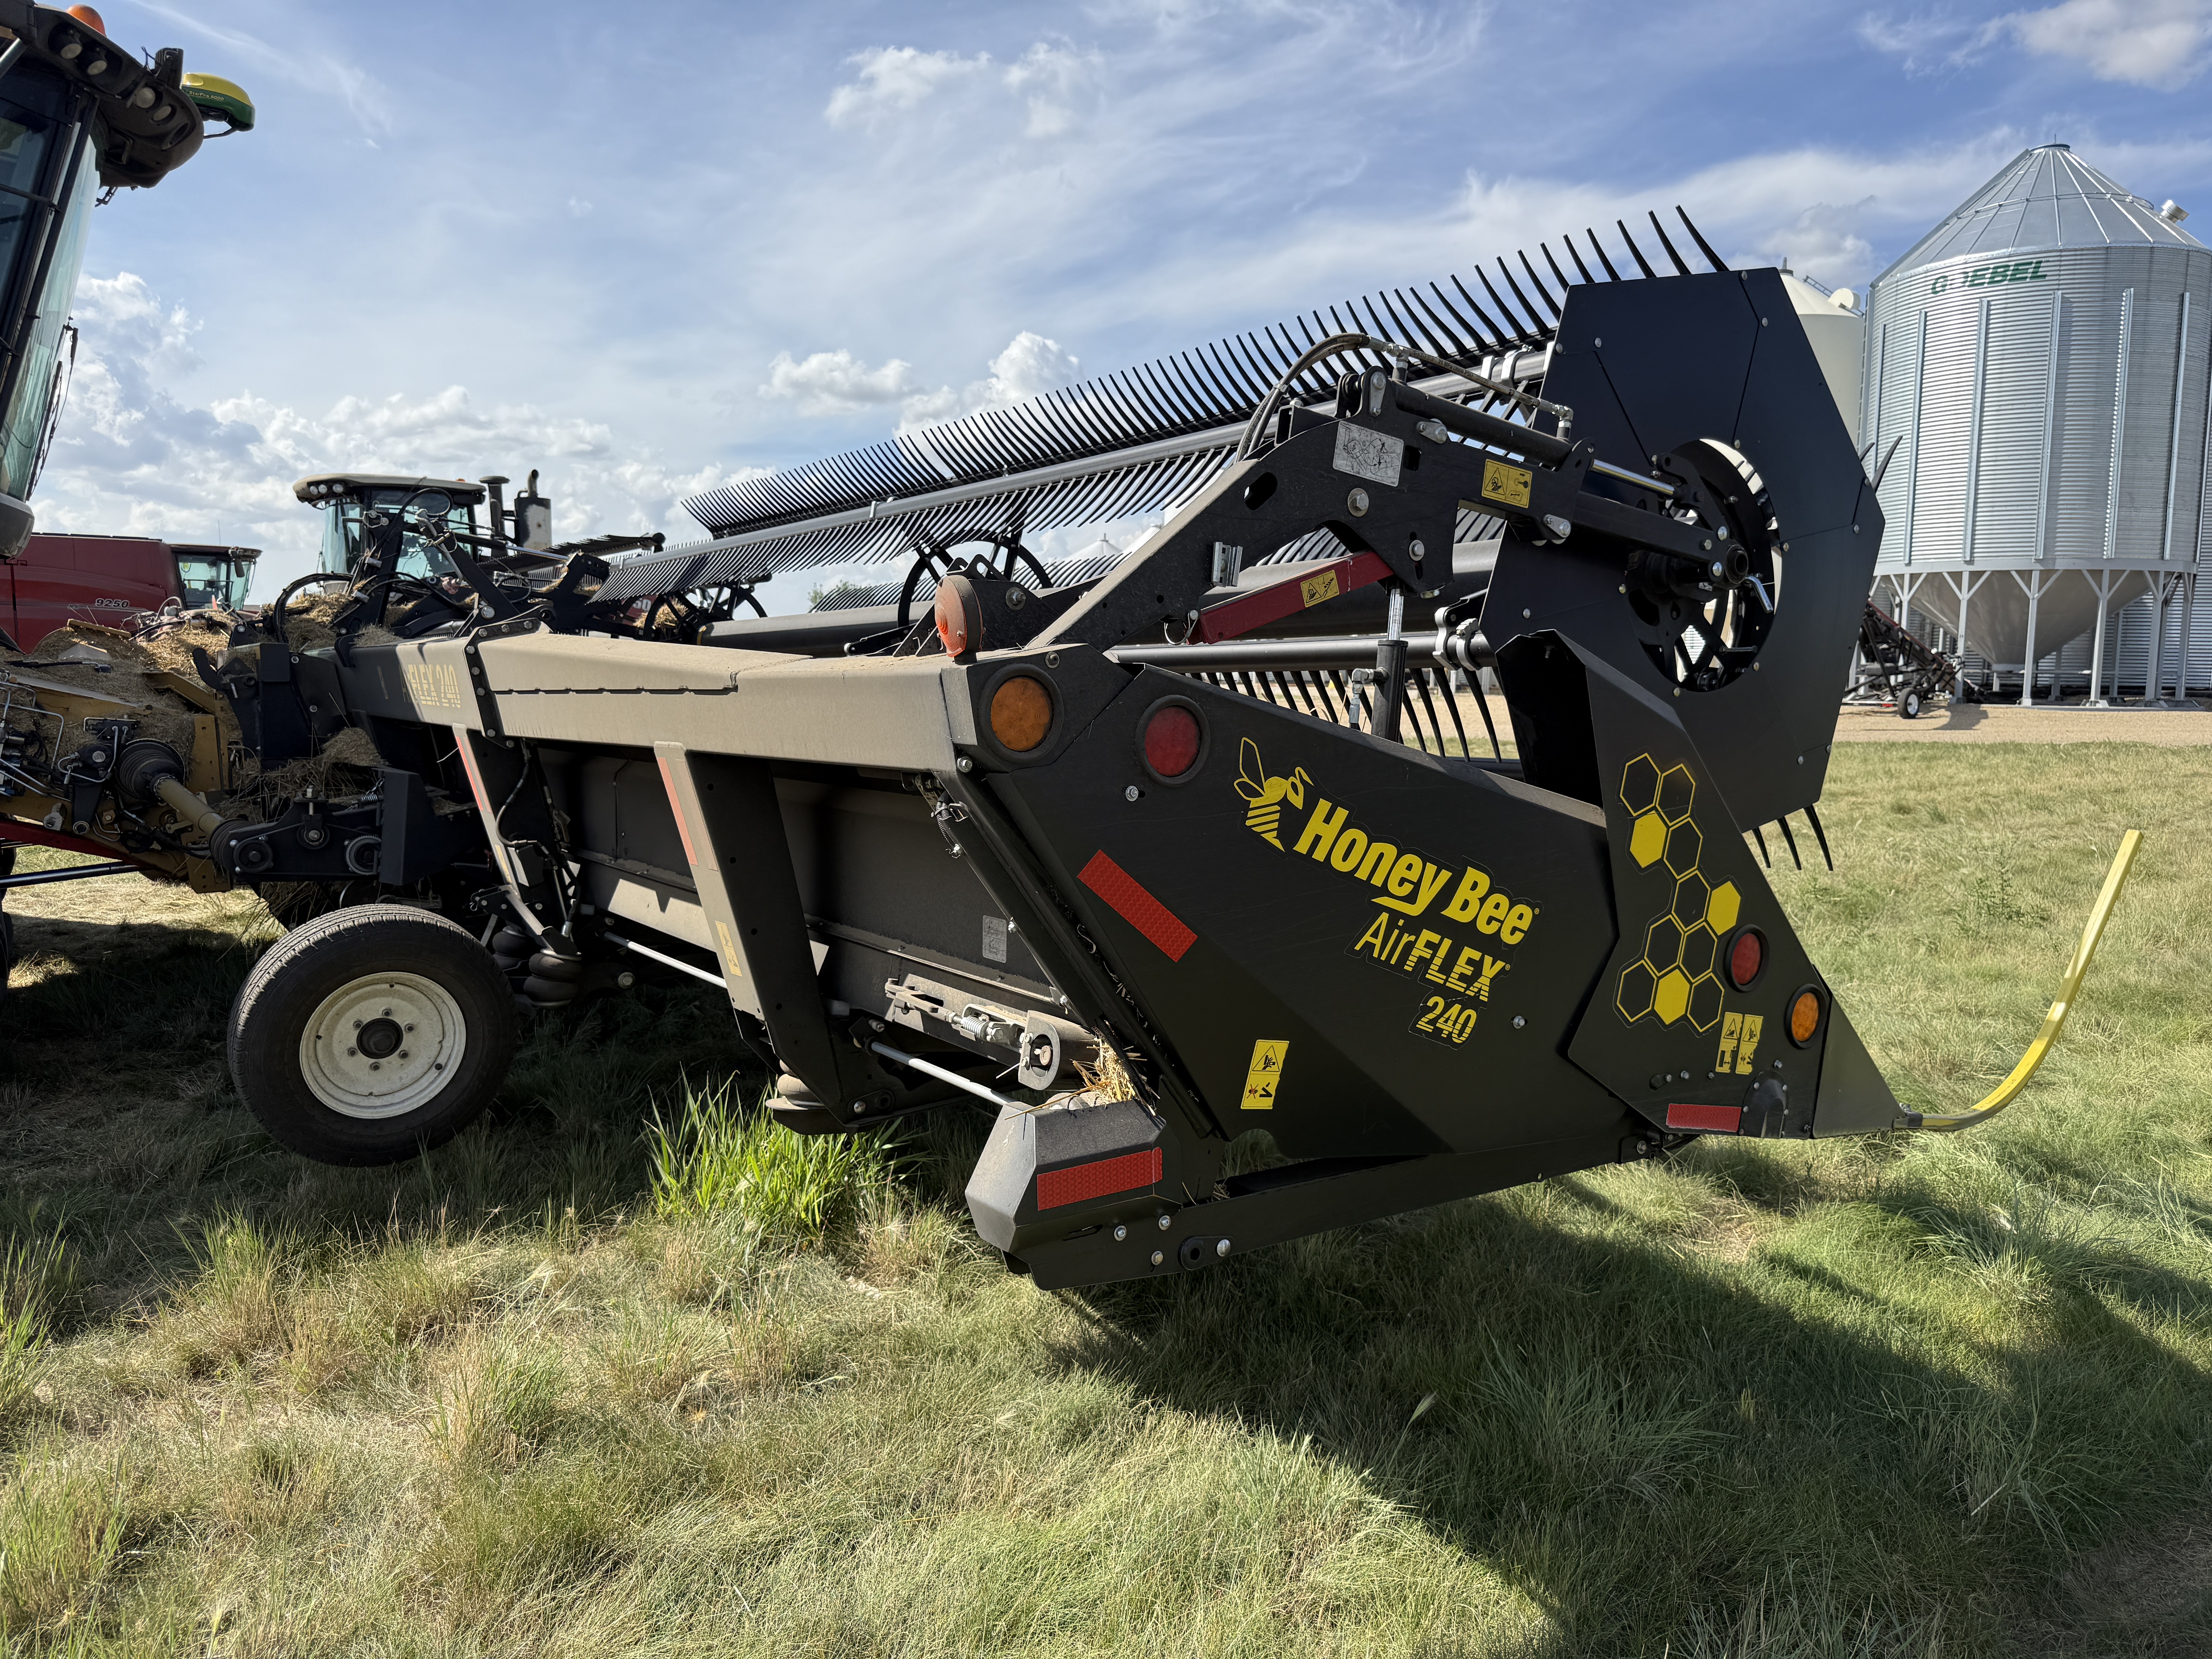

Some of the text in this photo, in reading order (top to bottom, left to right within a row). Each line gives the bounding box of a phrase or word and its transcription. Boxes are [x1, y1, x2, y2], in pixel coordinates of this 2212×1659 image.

[96, 598, 130, 608] 9250
[436, 665, 461, 708] 240
[1293, 798, 1534, 945] Honey Bee
[1354, 912, 1506, 1001] AirFLEX
[1416, 996, 1477, 1043] 240
